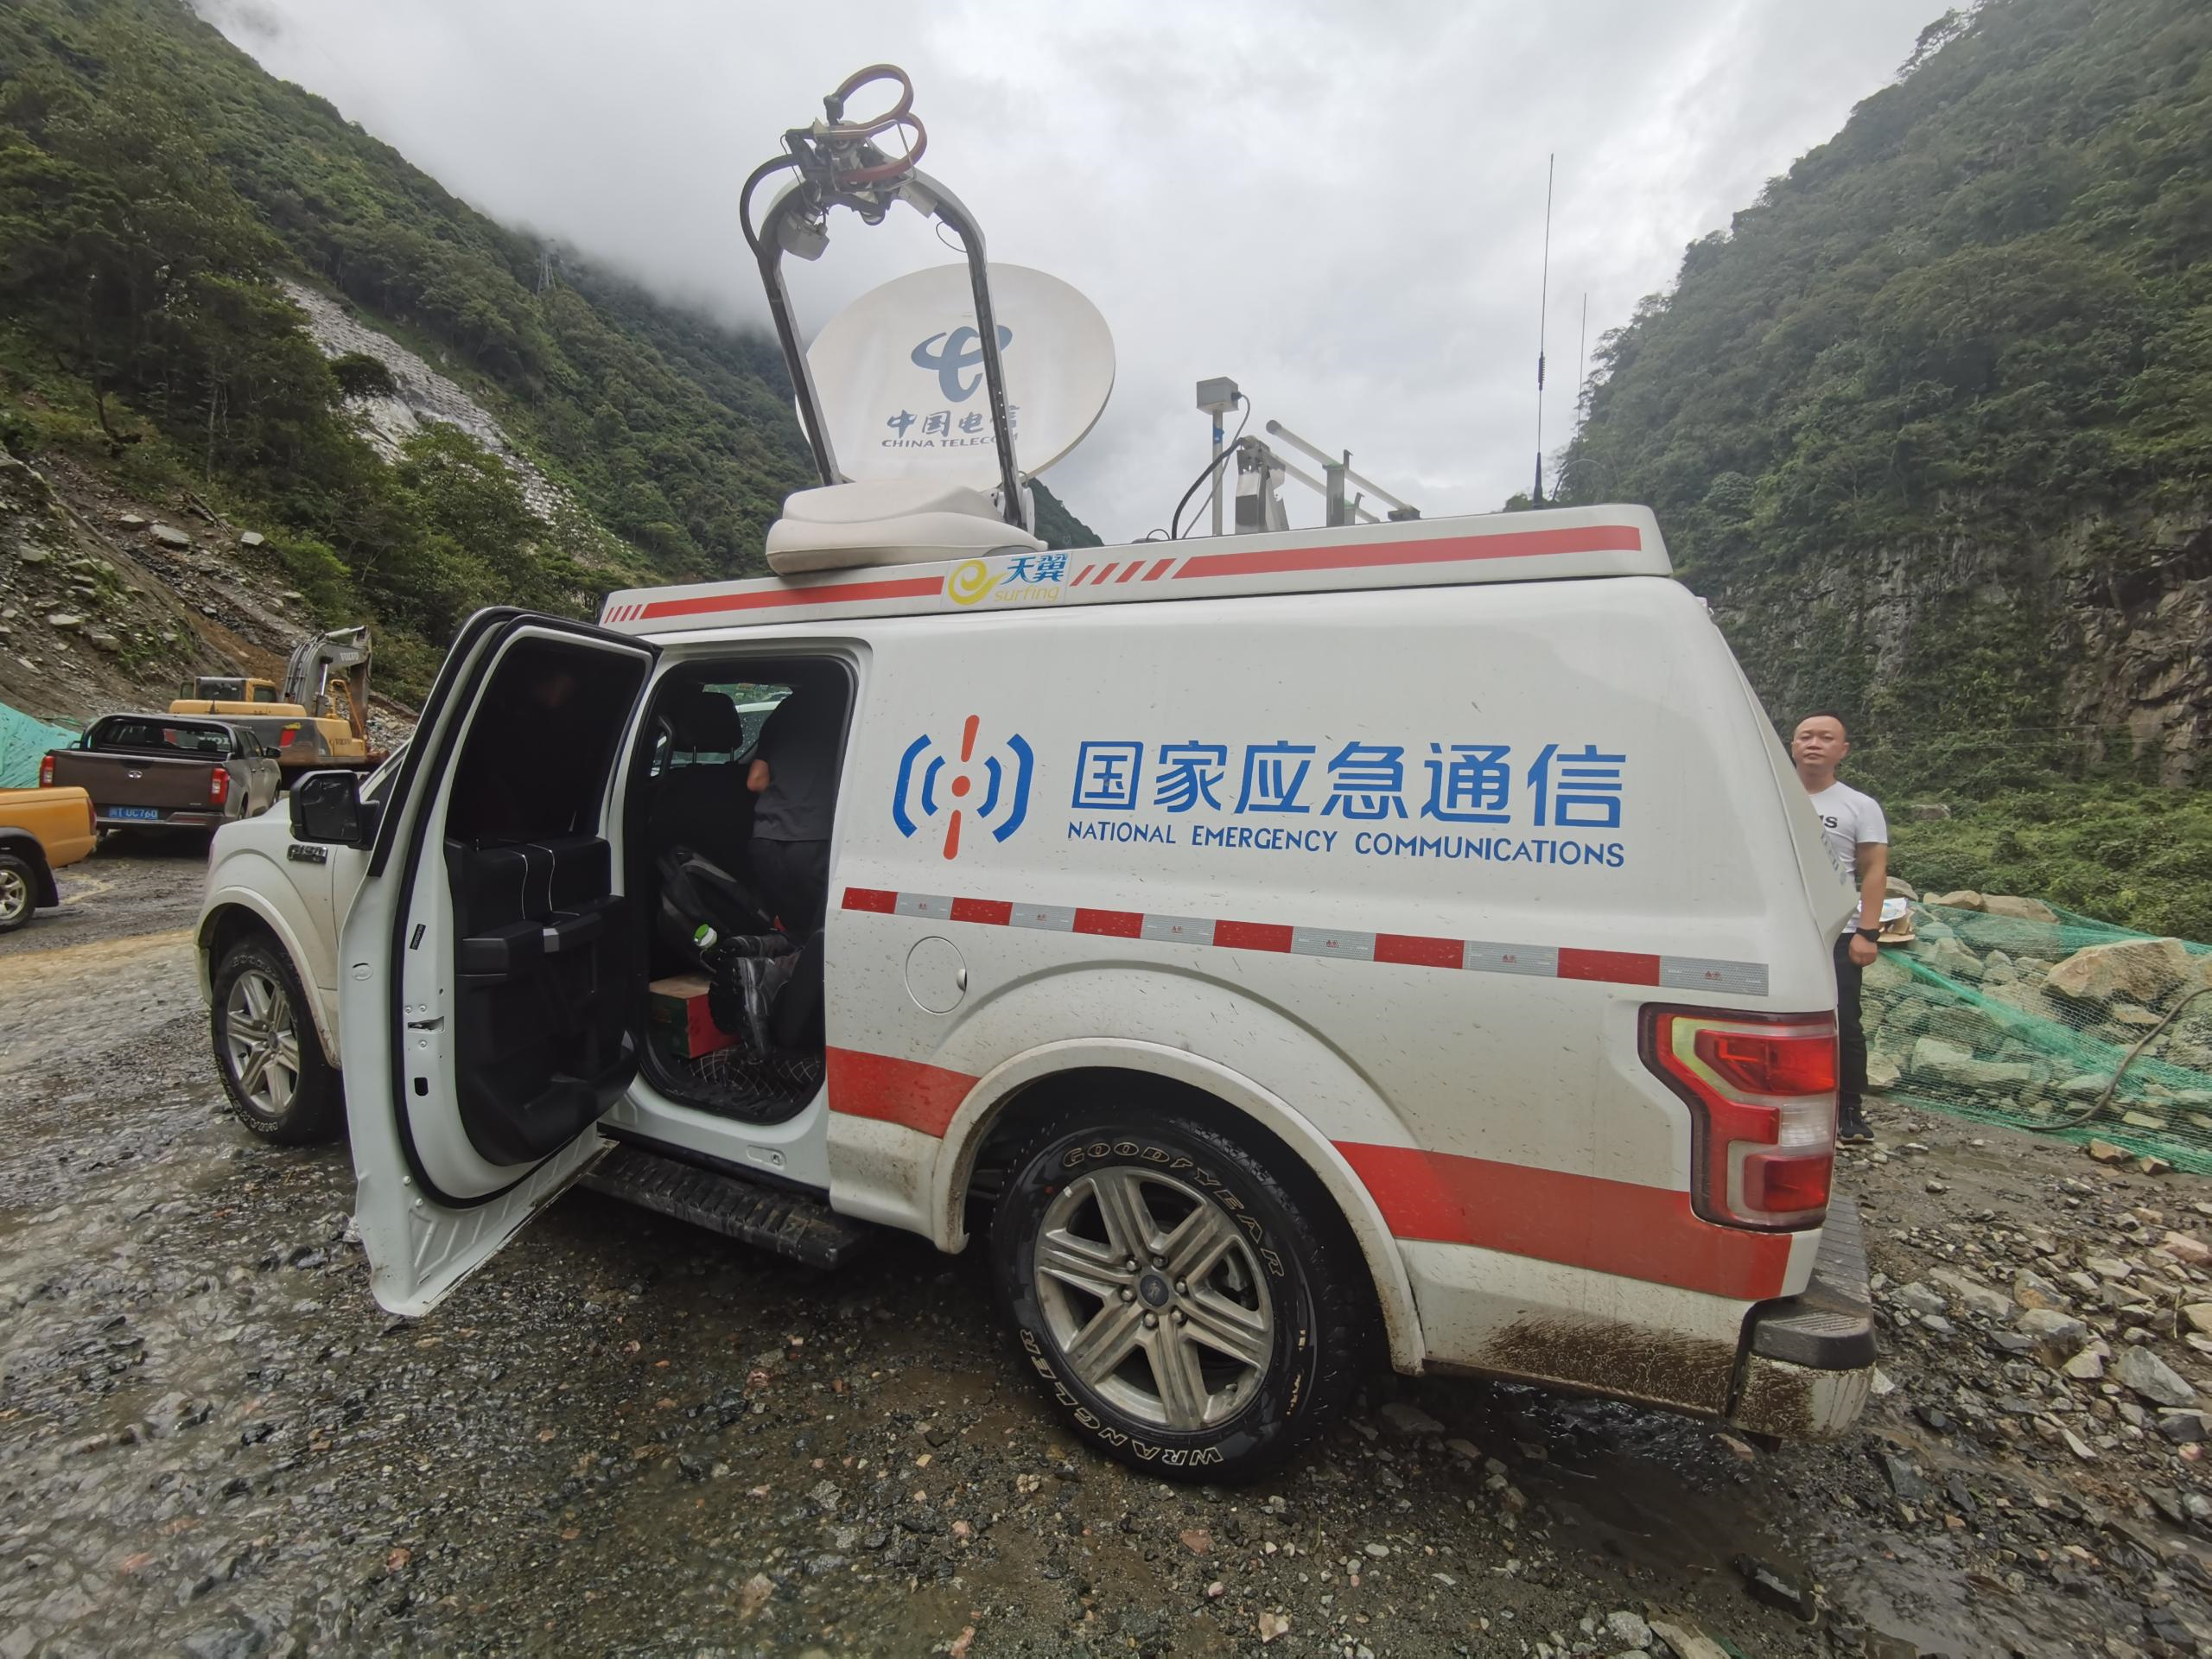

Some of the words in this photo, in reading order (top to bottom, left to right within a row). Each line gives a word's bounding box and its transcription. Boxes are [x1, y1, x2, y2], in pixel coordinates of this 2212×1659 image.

[881, 439, 935, 448] CHINA
[1000, 553, 1068, 585] 天翼
[995, 585, 1059, 602] surfing
[1071, 740, 1626, 829] 国家应急通信
[1067, 821, 1176, 845] NATIONAL
[1192, 825, 1338, 854] EMERGENCY
[1355, 832, 1625, 868] COMMUNICATIONS
[1064, 1142, 1284, 1276] GOODYEAR
[1020, 1329, 1224, 1465] WRANGLER
